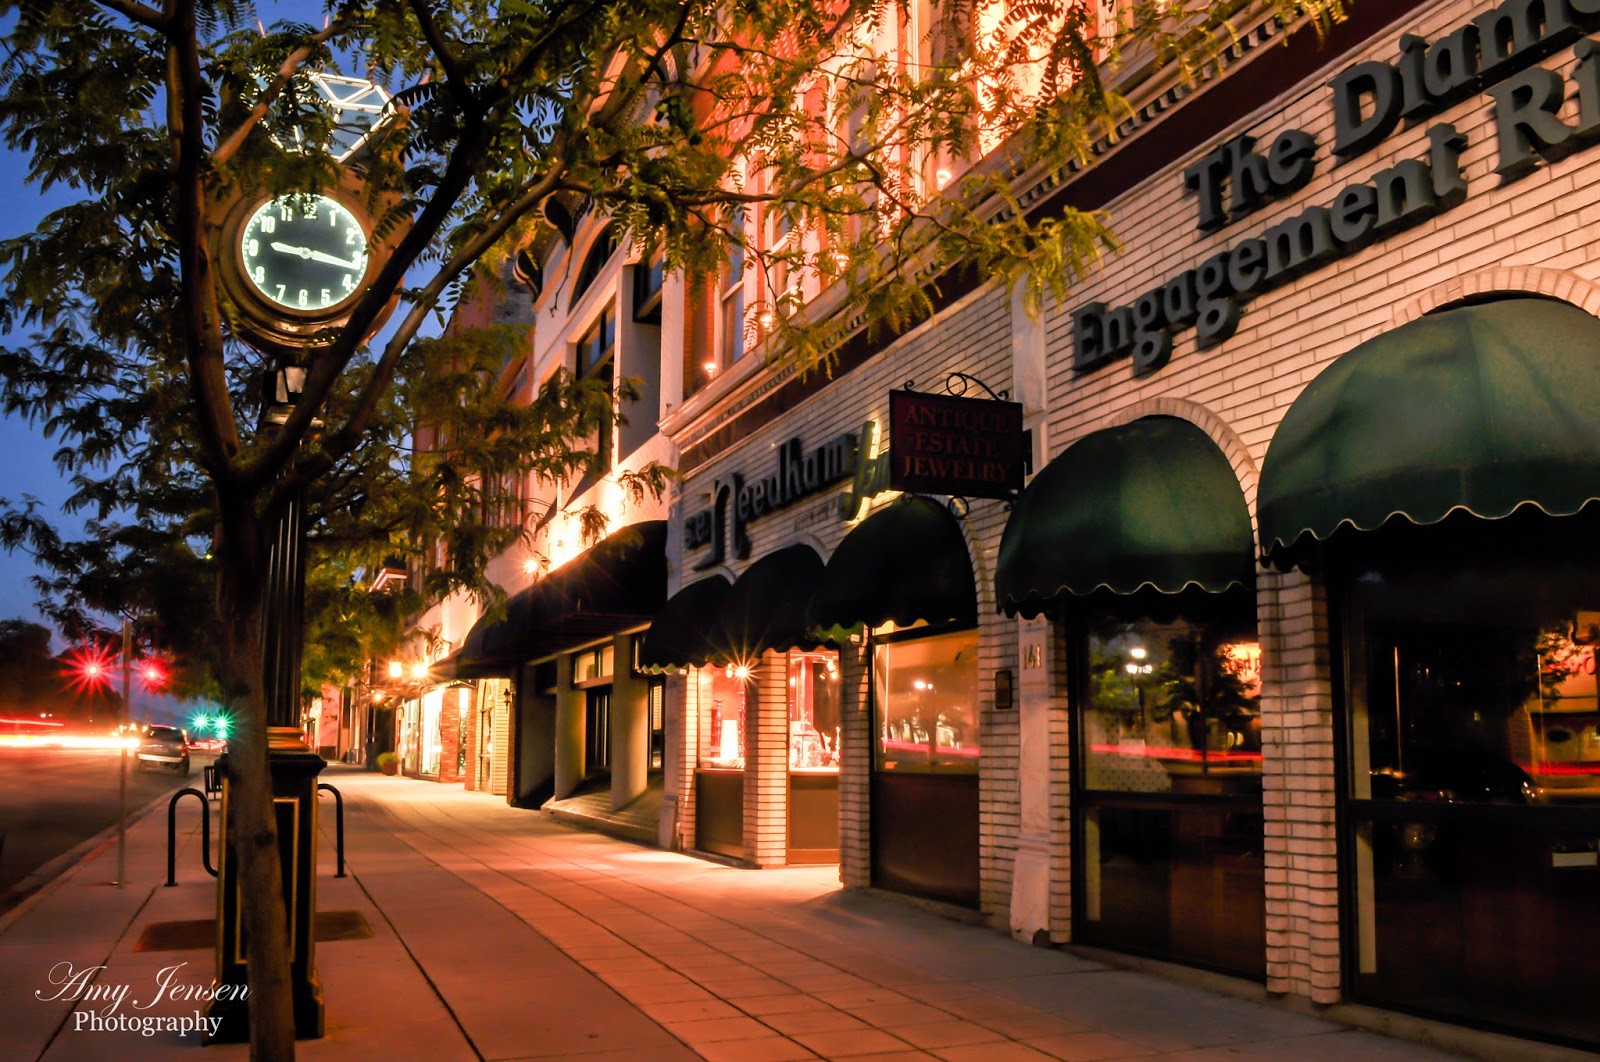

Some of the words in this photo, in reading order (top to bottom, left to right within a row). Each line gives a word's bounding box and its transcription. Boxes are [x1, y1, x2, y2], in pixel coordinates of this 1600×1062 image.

[1184, 129, 1316, 232] The
[1327, 0, 1600, 155] Diam
[261, 215, 275, 233] 10
[329, 210, 336, 227] 1
[346, 228, 355, 245] 2
[1071, 122, 1468, 379] Engagement
[256, 266, 265, 283] 8
[342, 274, 352, 290] 4
[276, 285, 286, 302] 7
[299, 289, 308, 306] 6
[321, 289, 331, 305] 5
[904, 401, 1016, 433] ANTIQUE
[914, 430, 1000, 459] ESTATE
[904, 455, 1011, 483] JEWELRY
